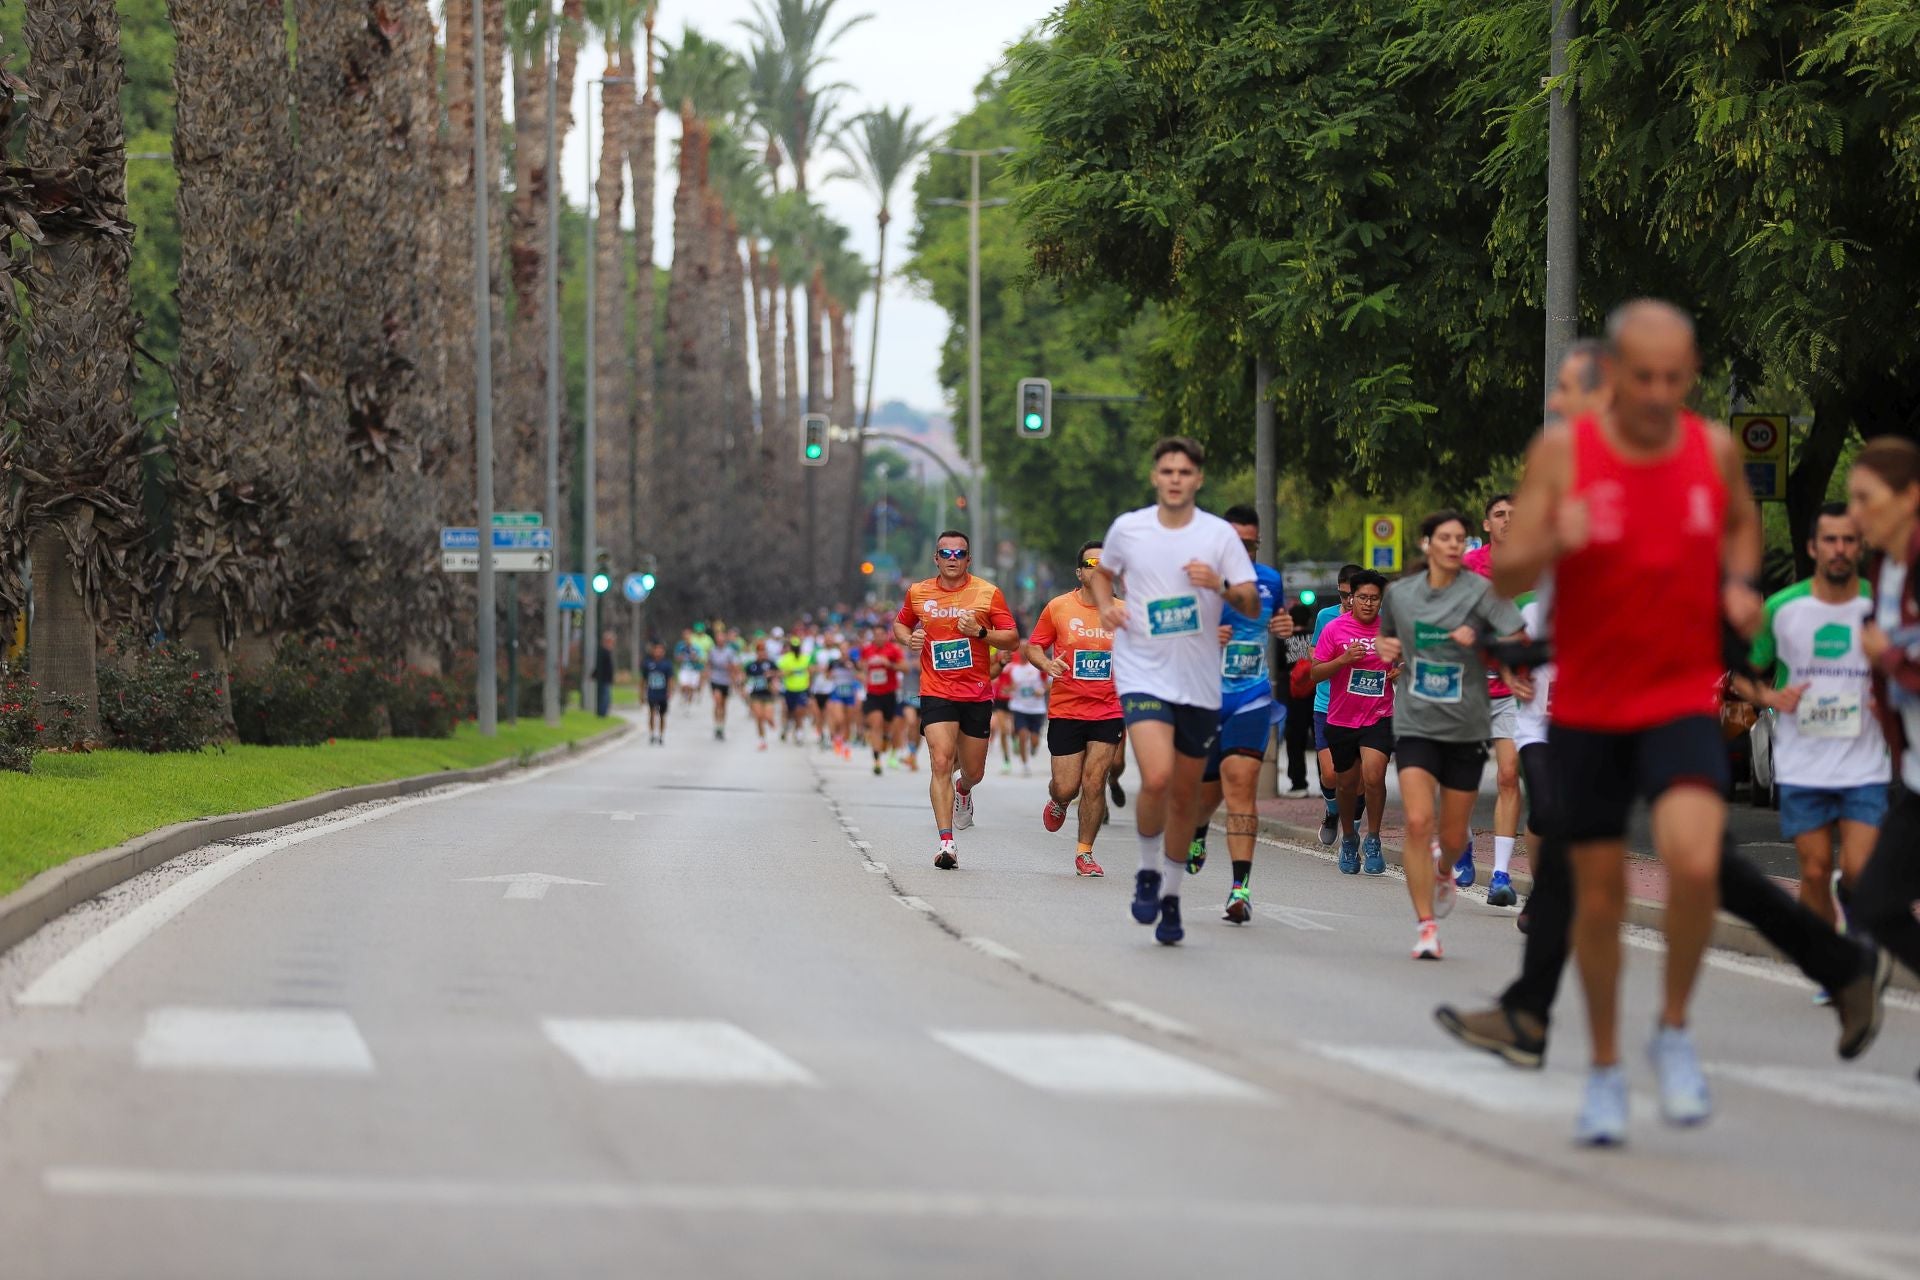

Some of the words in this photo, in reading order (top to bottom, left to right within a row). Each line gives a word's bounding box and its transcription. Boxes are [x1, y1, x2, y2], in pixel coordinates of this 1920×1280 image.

[1750, 429, 1770, 443] 30
[1077, 627, 1115, 640] solte
[939, 649, 965, 660] 1075
[1081, 659, 1106, 669] 1074
[1359, 677, 1378, 687] 572
